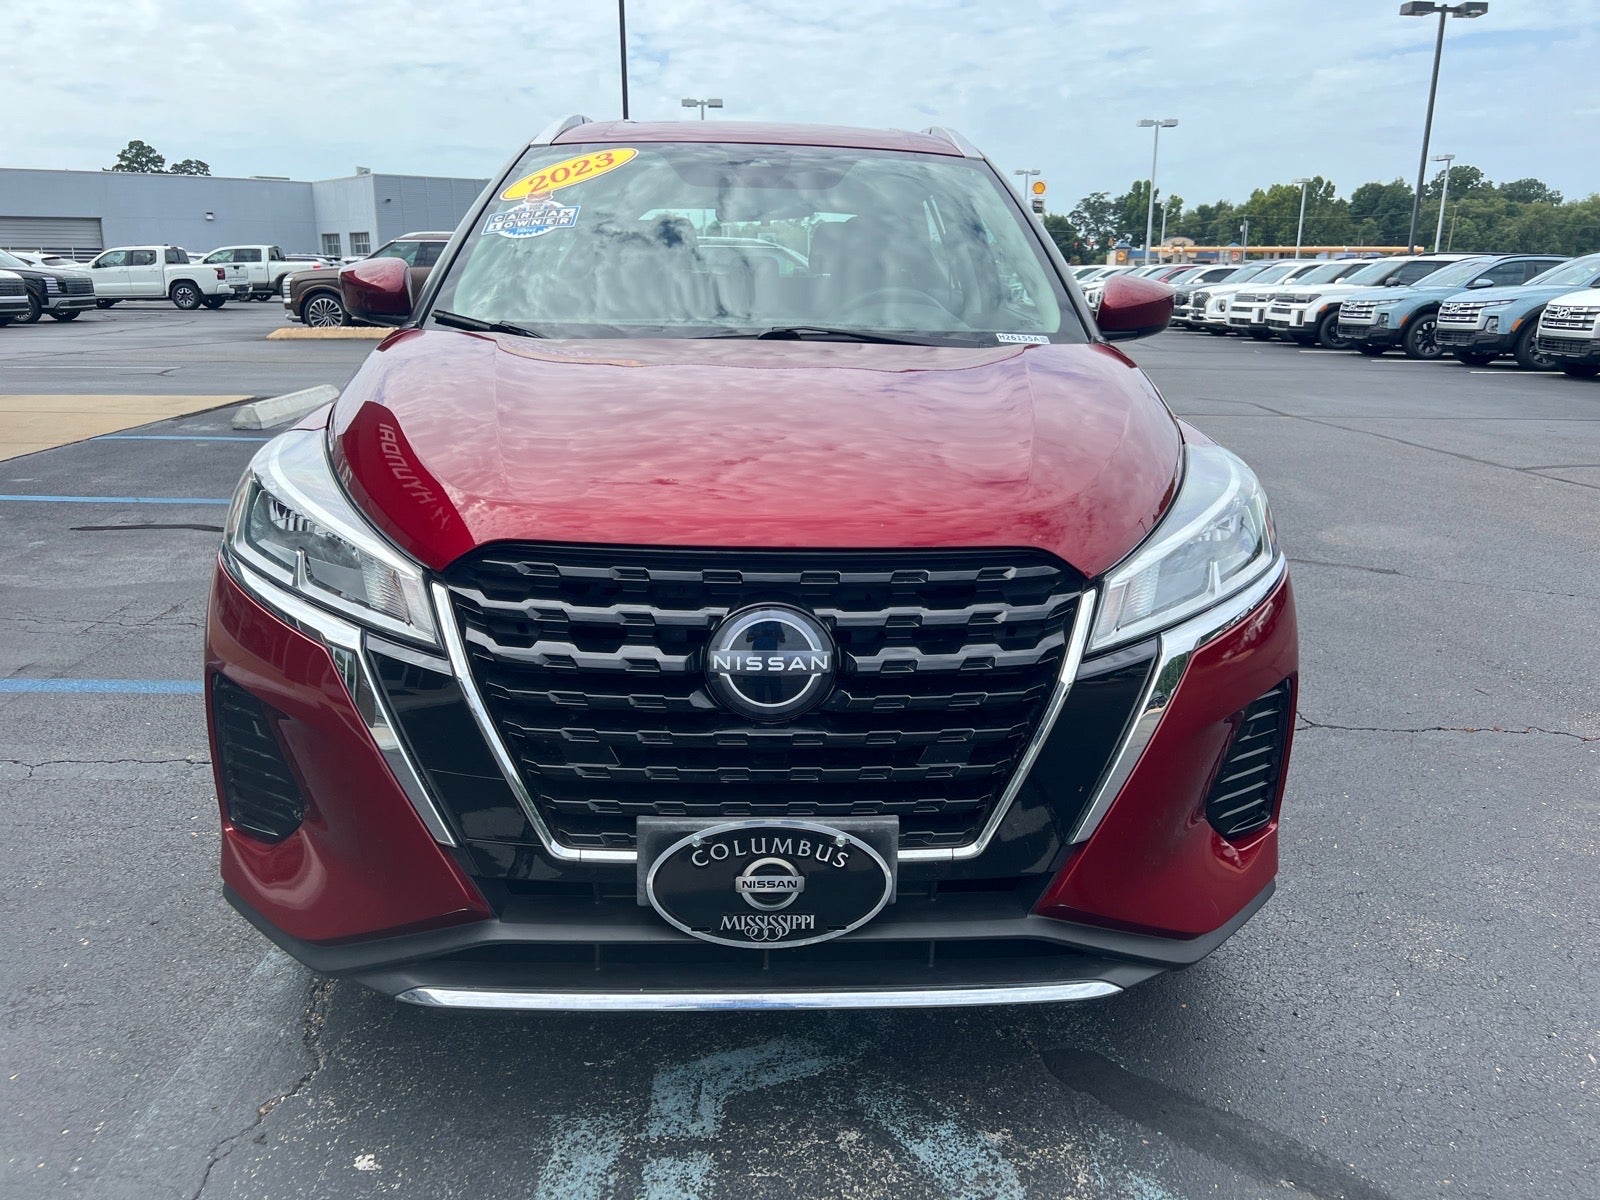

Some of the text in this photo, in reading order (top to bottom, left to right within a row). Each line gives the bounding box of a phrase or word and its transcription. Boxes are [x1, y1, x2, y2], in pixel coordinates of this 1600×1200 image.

[528, 152, 615, 193] 2023
[493, 207, 573, 222] CARFAX
[503, 217, 570, 228] OWNER
[713, 655, 828, 671] NISSAN
[691, 837, 849, 868] COLUMBUS
[741, 880, 798, 889] NISSAN
[720, 914, 816, 942] MISSISSIPPI
